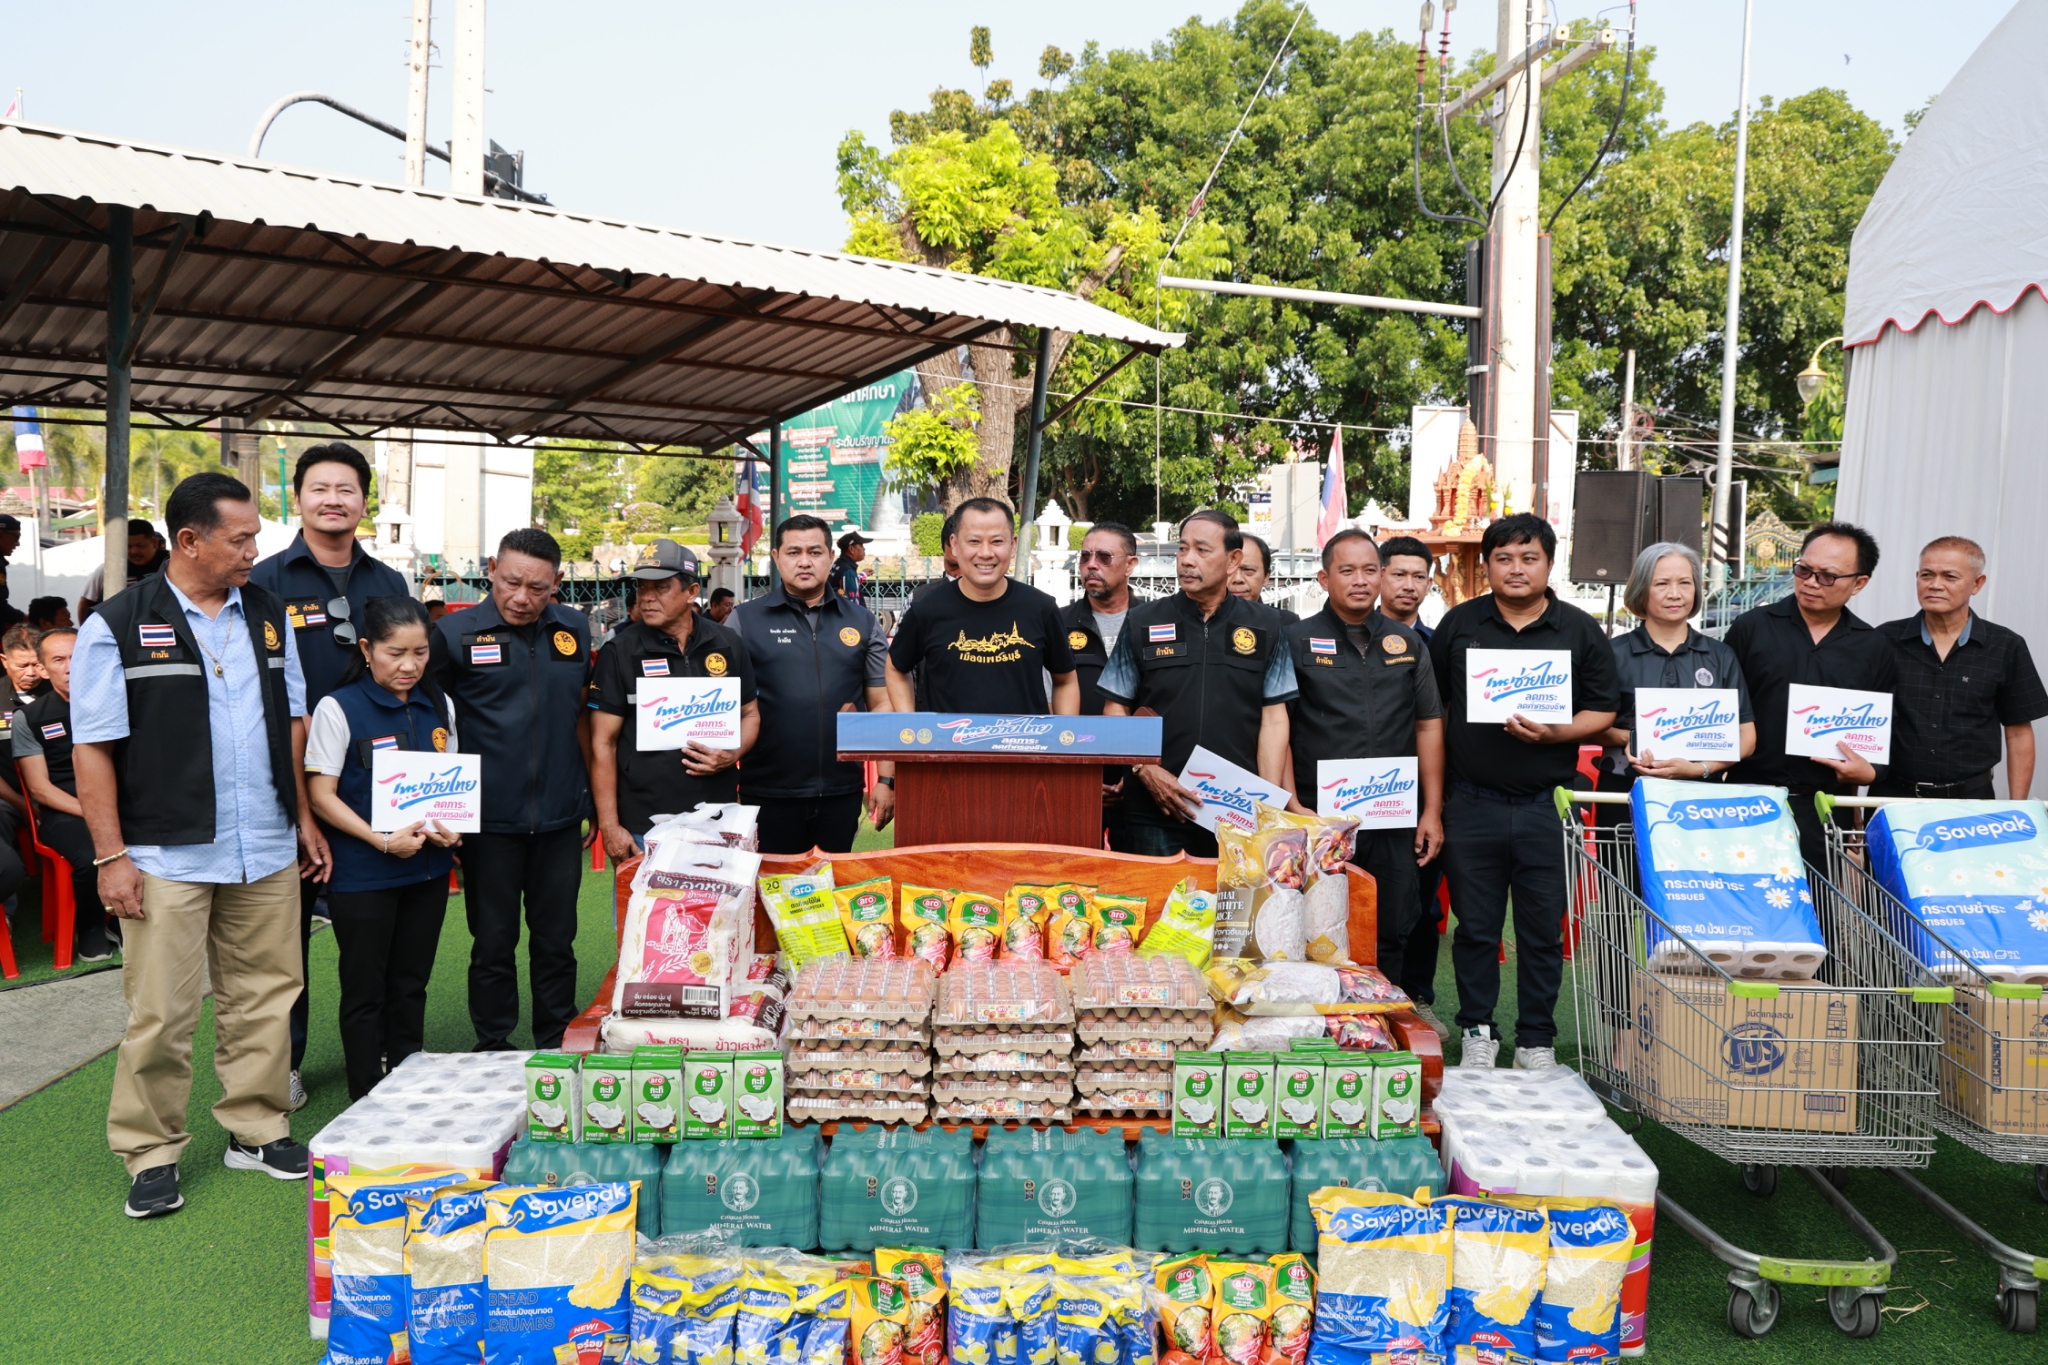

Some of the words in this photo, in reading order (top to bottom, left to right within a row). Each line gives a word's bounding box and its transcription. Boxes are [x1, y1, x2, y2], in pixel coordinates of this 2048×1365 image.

[476, 634, 496, 643] กำนัน
[151, 649, 170, 659] กำนัน
[1156, 646, 1175, 656] กำนัน
[1525, 692, 1558, 701] ลดภาระ
[1517, 701, 1566, 711] ลดค่าครองชีพ
[694, 719, 727, 728] ลดภาระ
[686, 729, 735, 738] ลดค่าครองชีพ
[1694, 731, 1725, 740] ลดภาระ
[1844, 732, 1877, 742] ลดภาระ
[1686, 740, 1734, 749] ลดค่าครองชีพ
[433, 800, 466, 809] ลดภาระ
[1373, 800, 1404, 808] ลดภาระ
[425, 811, 475, 819] ลดค่าครองชีพ
[1365, 808, 1412, 817] ลดค่าครองชีพ
[1685, 799, 1776, 822] Savepak
[1935, 815, 2031, 842] Savepak
[766, 880, 780, 891] 20
[1664, 877, 1745, 891] กระดาษชำระ
[794, 885, 812, 895] aro
[859, 896, 874, 905] aro
[1063, 896, 1077, 904] aro
[1666, 892, 1705, 901] TISSUES
[1021, 898, 1037, 907] aro
[974, 904, 989, 912] aro
[1921, 903, 2006, 915] กระดาษชำระ
[1111, 910, 1125, 919] aro
[1924, 918, 1966, 927] TISSUES
[1694, 924, 1706, 935] 40
[1707, 922, 1725, 935] ม้วน
[702, 1078, 716, 1088] กะทิ
[751, 1076, 765, 1085] กะทิ
[1243, 1080, 1257, 1090] กะทิ
[1393, 1080, 1407, 1090] กะทิ
[541, 1084, 555, 1093] กะทิ
[599, 1086, 614, 1094] กะทิ
[649, 1085, 664, 1094] กะทิ
[1192, 1081, 1206, 1090] กะทิ
[1293, 1081, 1307, 1090] กะทิ
[1342, 1082, 1356, 1091] กะทิ
[529, 1182, 627, 1219] Savepak
[1352, 1208, 1441, 1230] Savepak
[709, 1221, 744, 1230] MINERAL
[746, 1222, 772, 1230] WATER
[868, 1225, 903, 1233] MINERAL
[905, 1226, 930, 1234] WATER
[1027, 1226, 1061, 1234] MINERAL
[1063, 1226, 1089, 1234] WATER
[1183, 1226, 1218, 1234] MINERAL
[1220, 1226, 1245, 1234] WATER
[1178, 1272, 1192, 1280] aro
[1291, 1268, 1307, 1277] aro
[1235, 1280, 1251, 1289] aro
[488, 1292, 539, 1306] BREAD
[703, 1287, 741, 1314] Savepak
[1063, 1301, 1100, 1312] Savepak
[488, 1316, 556, 1332] CRUMBS
[574, 1323, 599, 1334] NEW!
[1391, 1338, 1414, 1347] NEW!
[1475, 1334, 1500, 1343] NEW!
[577, 1338, 603, 1349] อร่อย
[1478, 1349, 1502, 1361] อร่อย
[1572, 1348, 1597, 1356] NEW!
